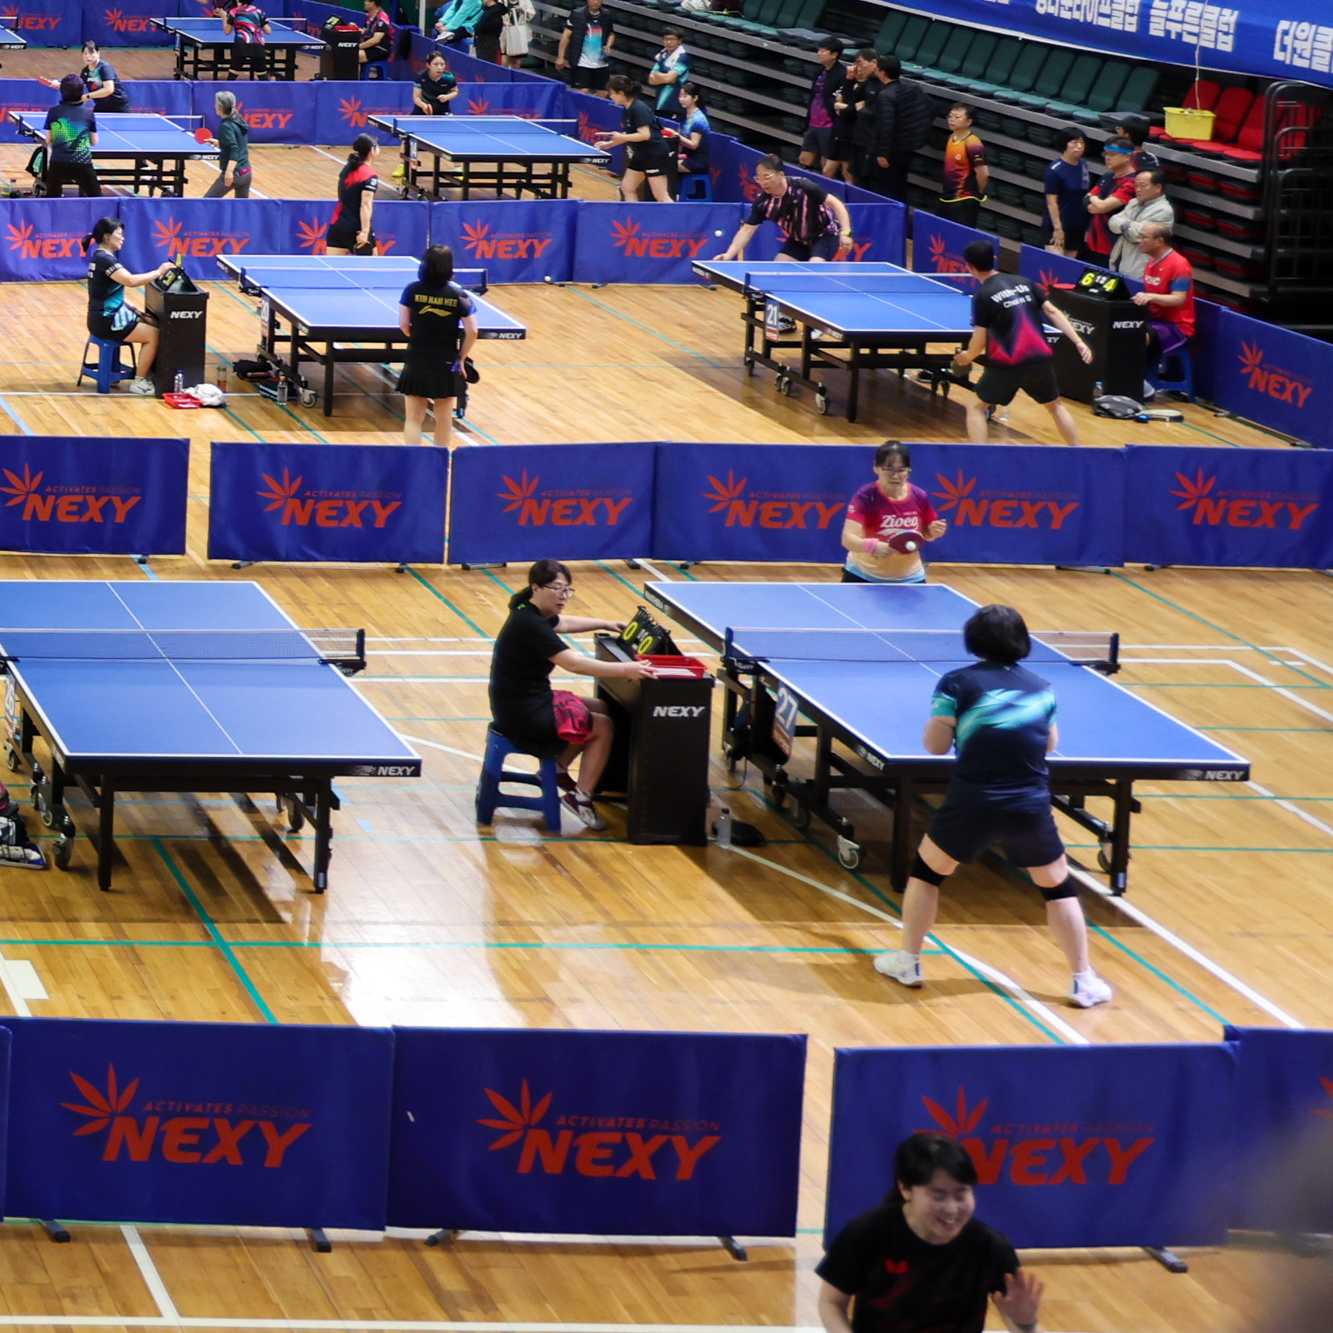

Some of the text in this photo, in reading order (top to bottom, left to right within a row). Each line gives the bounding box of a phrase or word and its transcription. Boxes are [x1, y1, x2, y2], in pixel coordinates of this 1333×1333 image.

[475, 239, 553, 259] NEXY
[1081, 272, 1119, 292] 6 4
[767, 304, 778, 326] 21
[1248, 367, 1313, 408] NEXY
[22, 493, 142, 523] NEXY
[281, 498, 403, 528] NEXY
[518, 497, 634, 526] NEXY
[954, 498, 1080, 529] NEXY
[653, 706, 705, 718] NEXY
[776, 687, 798, 730] 27
[376, 766, 415, 776] NEXY
[1205, 770, 1245, 781] NEXY
[102, 1115, 313, 1169] NEXY
[517, 1128, 722, 1181] NEXY
[960, 1137, 1156, 1187] NEXY
